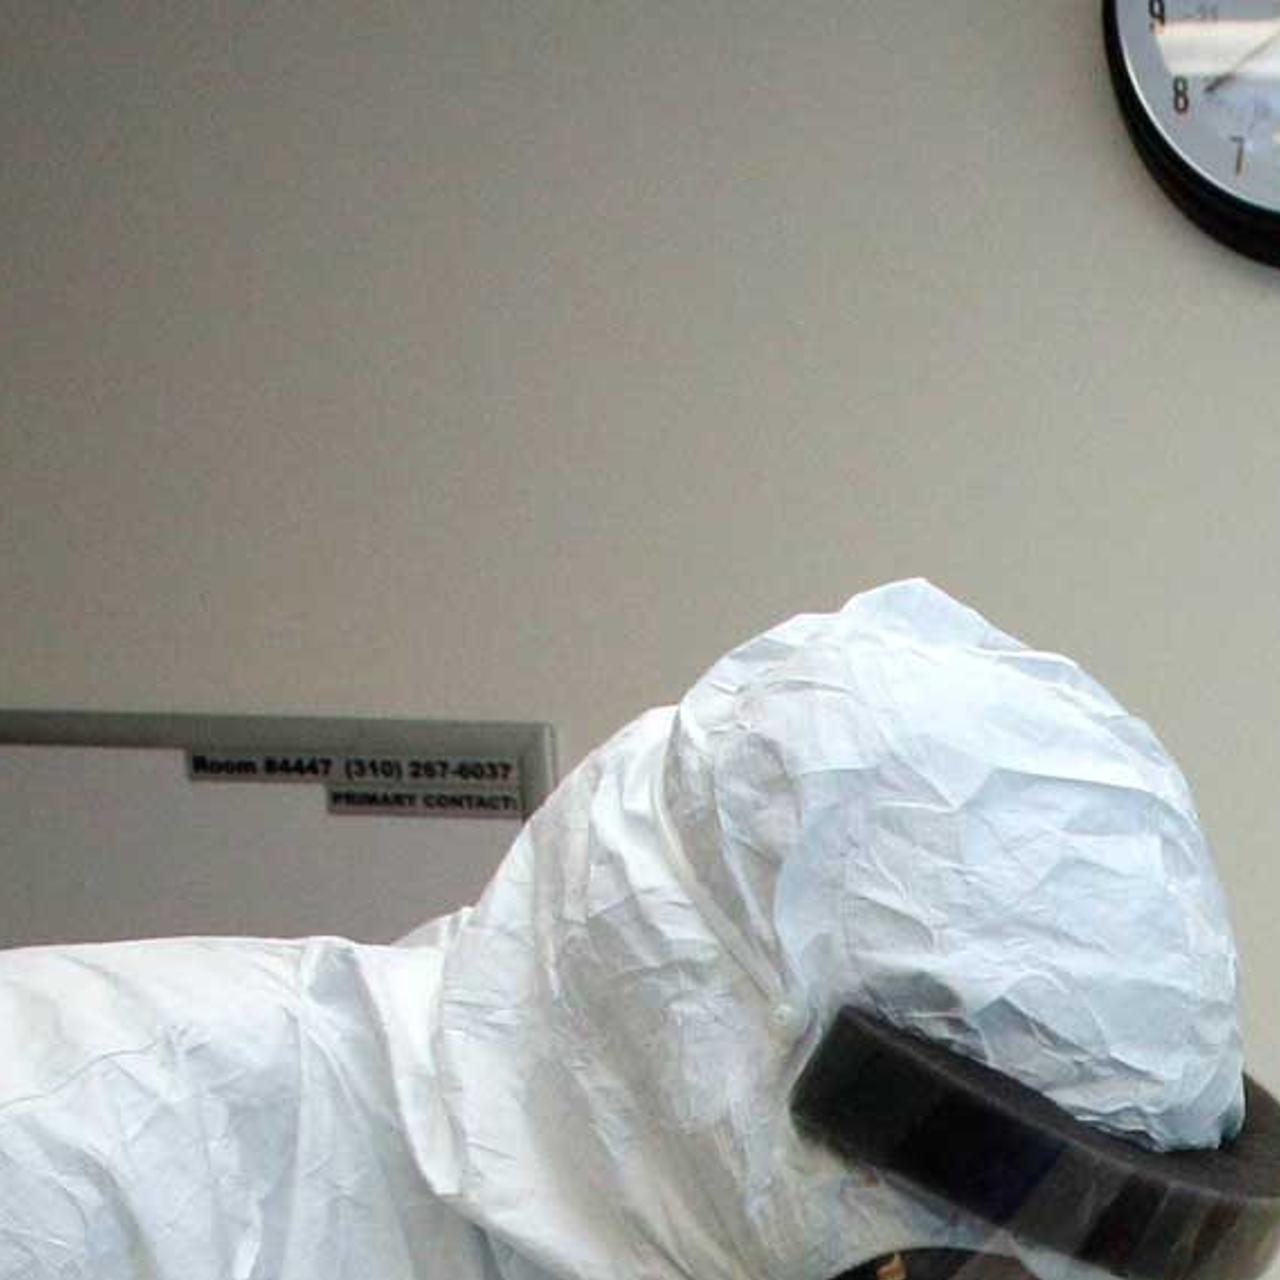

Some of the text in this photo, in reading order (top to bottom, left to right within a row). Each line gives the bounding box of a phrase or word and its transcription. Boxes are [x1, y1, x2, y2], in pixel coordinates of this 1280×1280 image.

[1173, 75, 1189, 114] 8
[1229, 135, 1244, 176] 7
[193, 755, 258, 775] Room
[345, 758, 403, 782] (310)
[333, 792, 417, 808] PRIMARY
